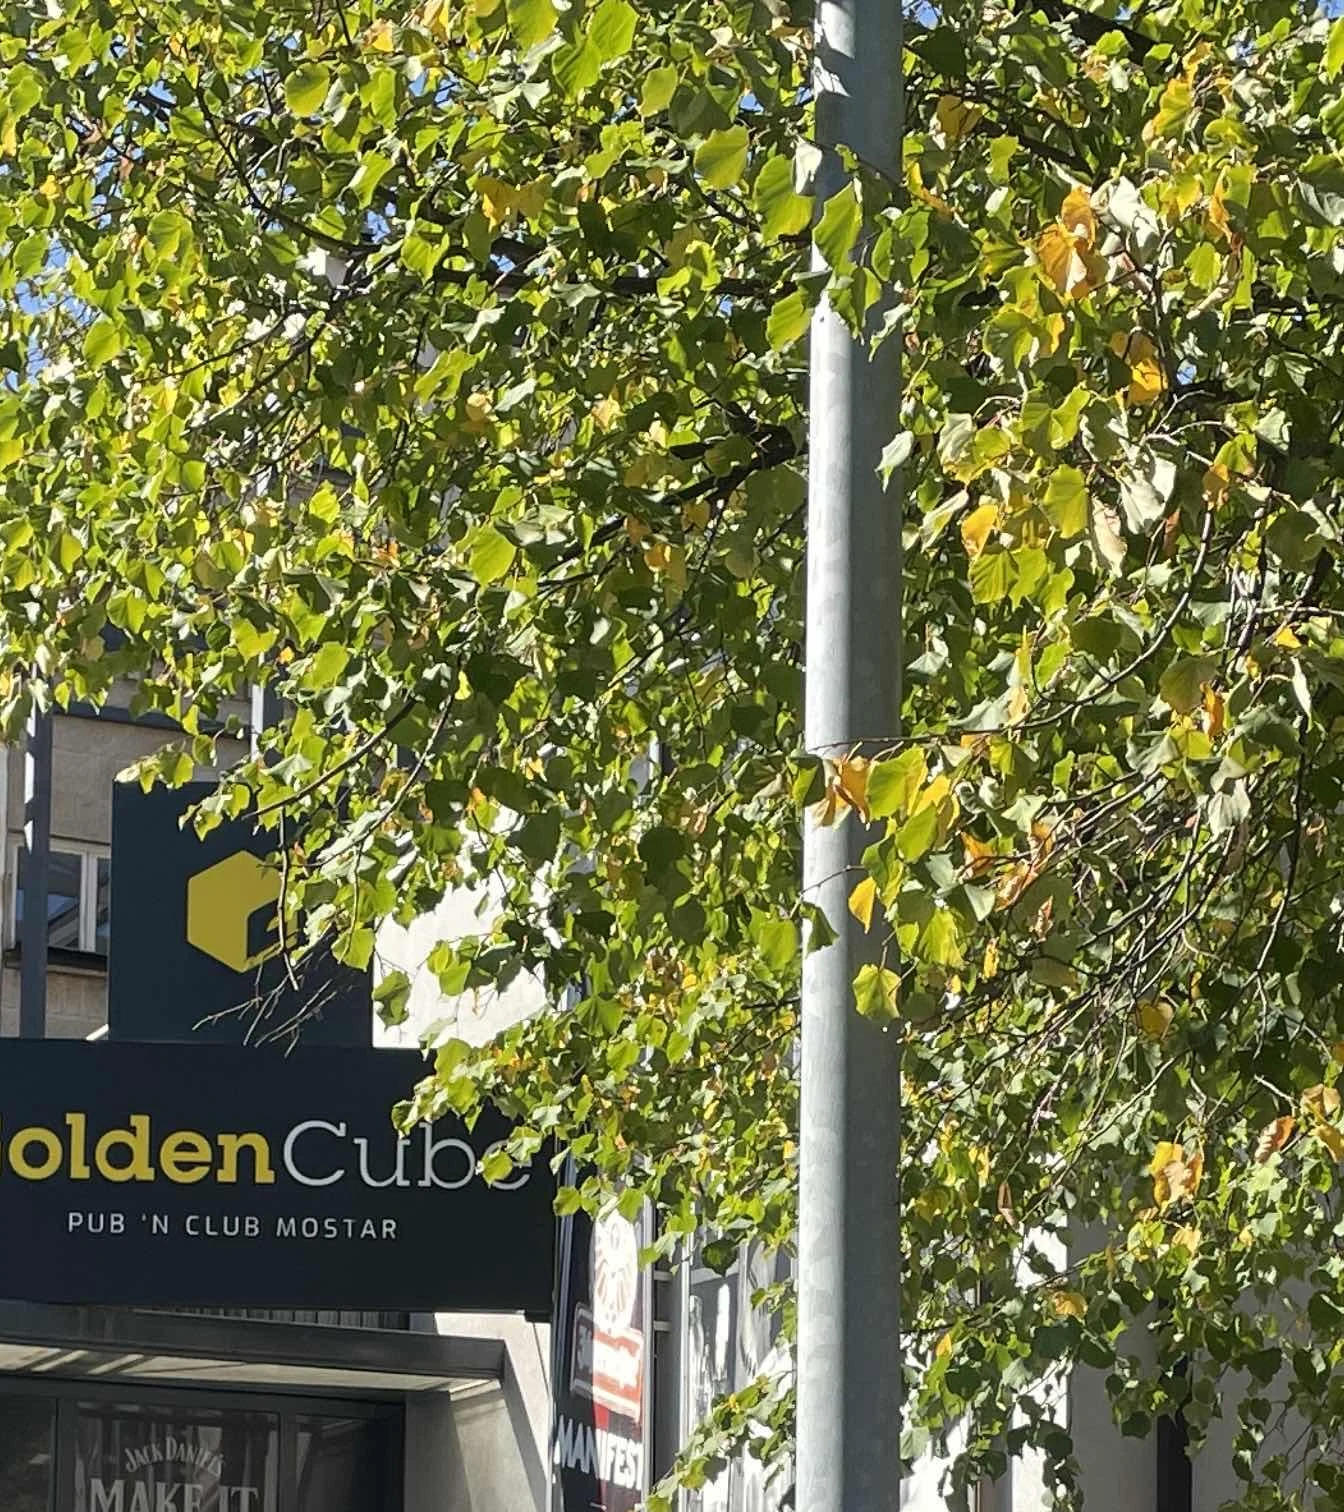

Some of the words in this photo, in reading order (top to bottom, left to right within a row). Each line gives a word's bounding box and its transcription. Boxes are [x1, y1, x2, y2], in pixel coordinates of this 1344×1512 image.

[68, 1212, 124, 1234] PUB
[185, 1215, 260, 1237] CLUB
[276, 1217, 397, 1240] MOSTAR
[125, 1443, 163, 1473] JACK
